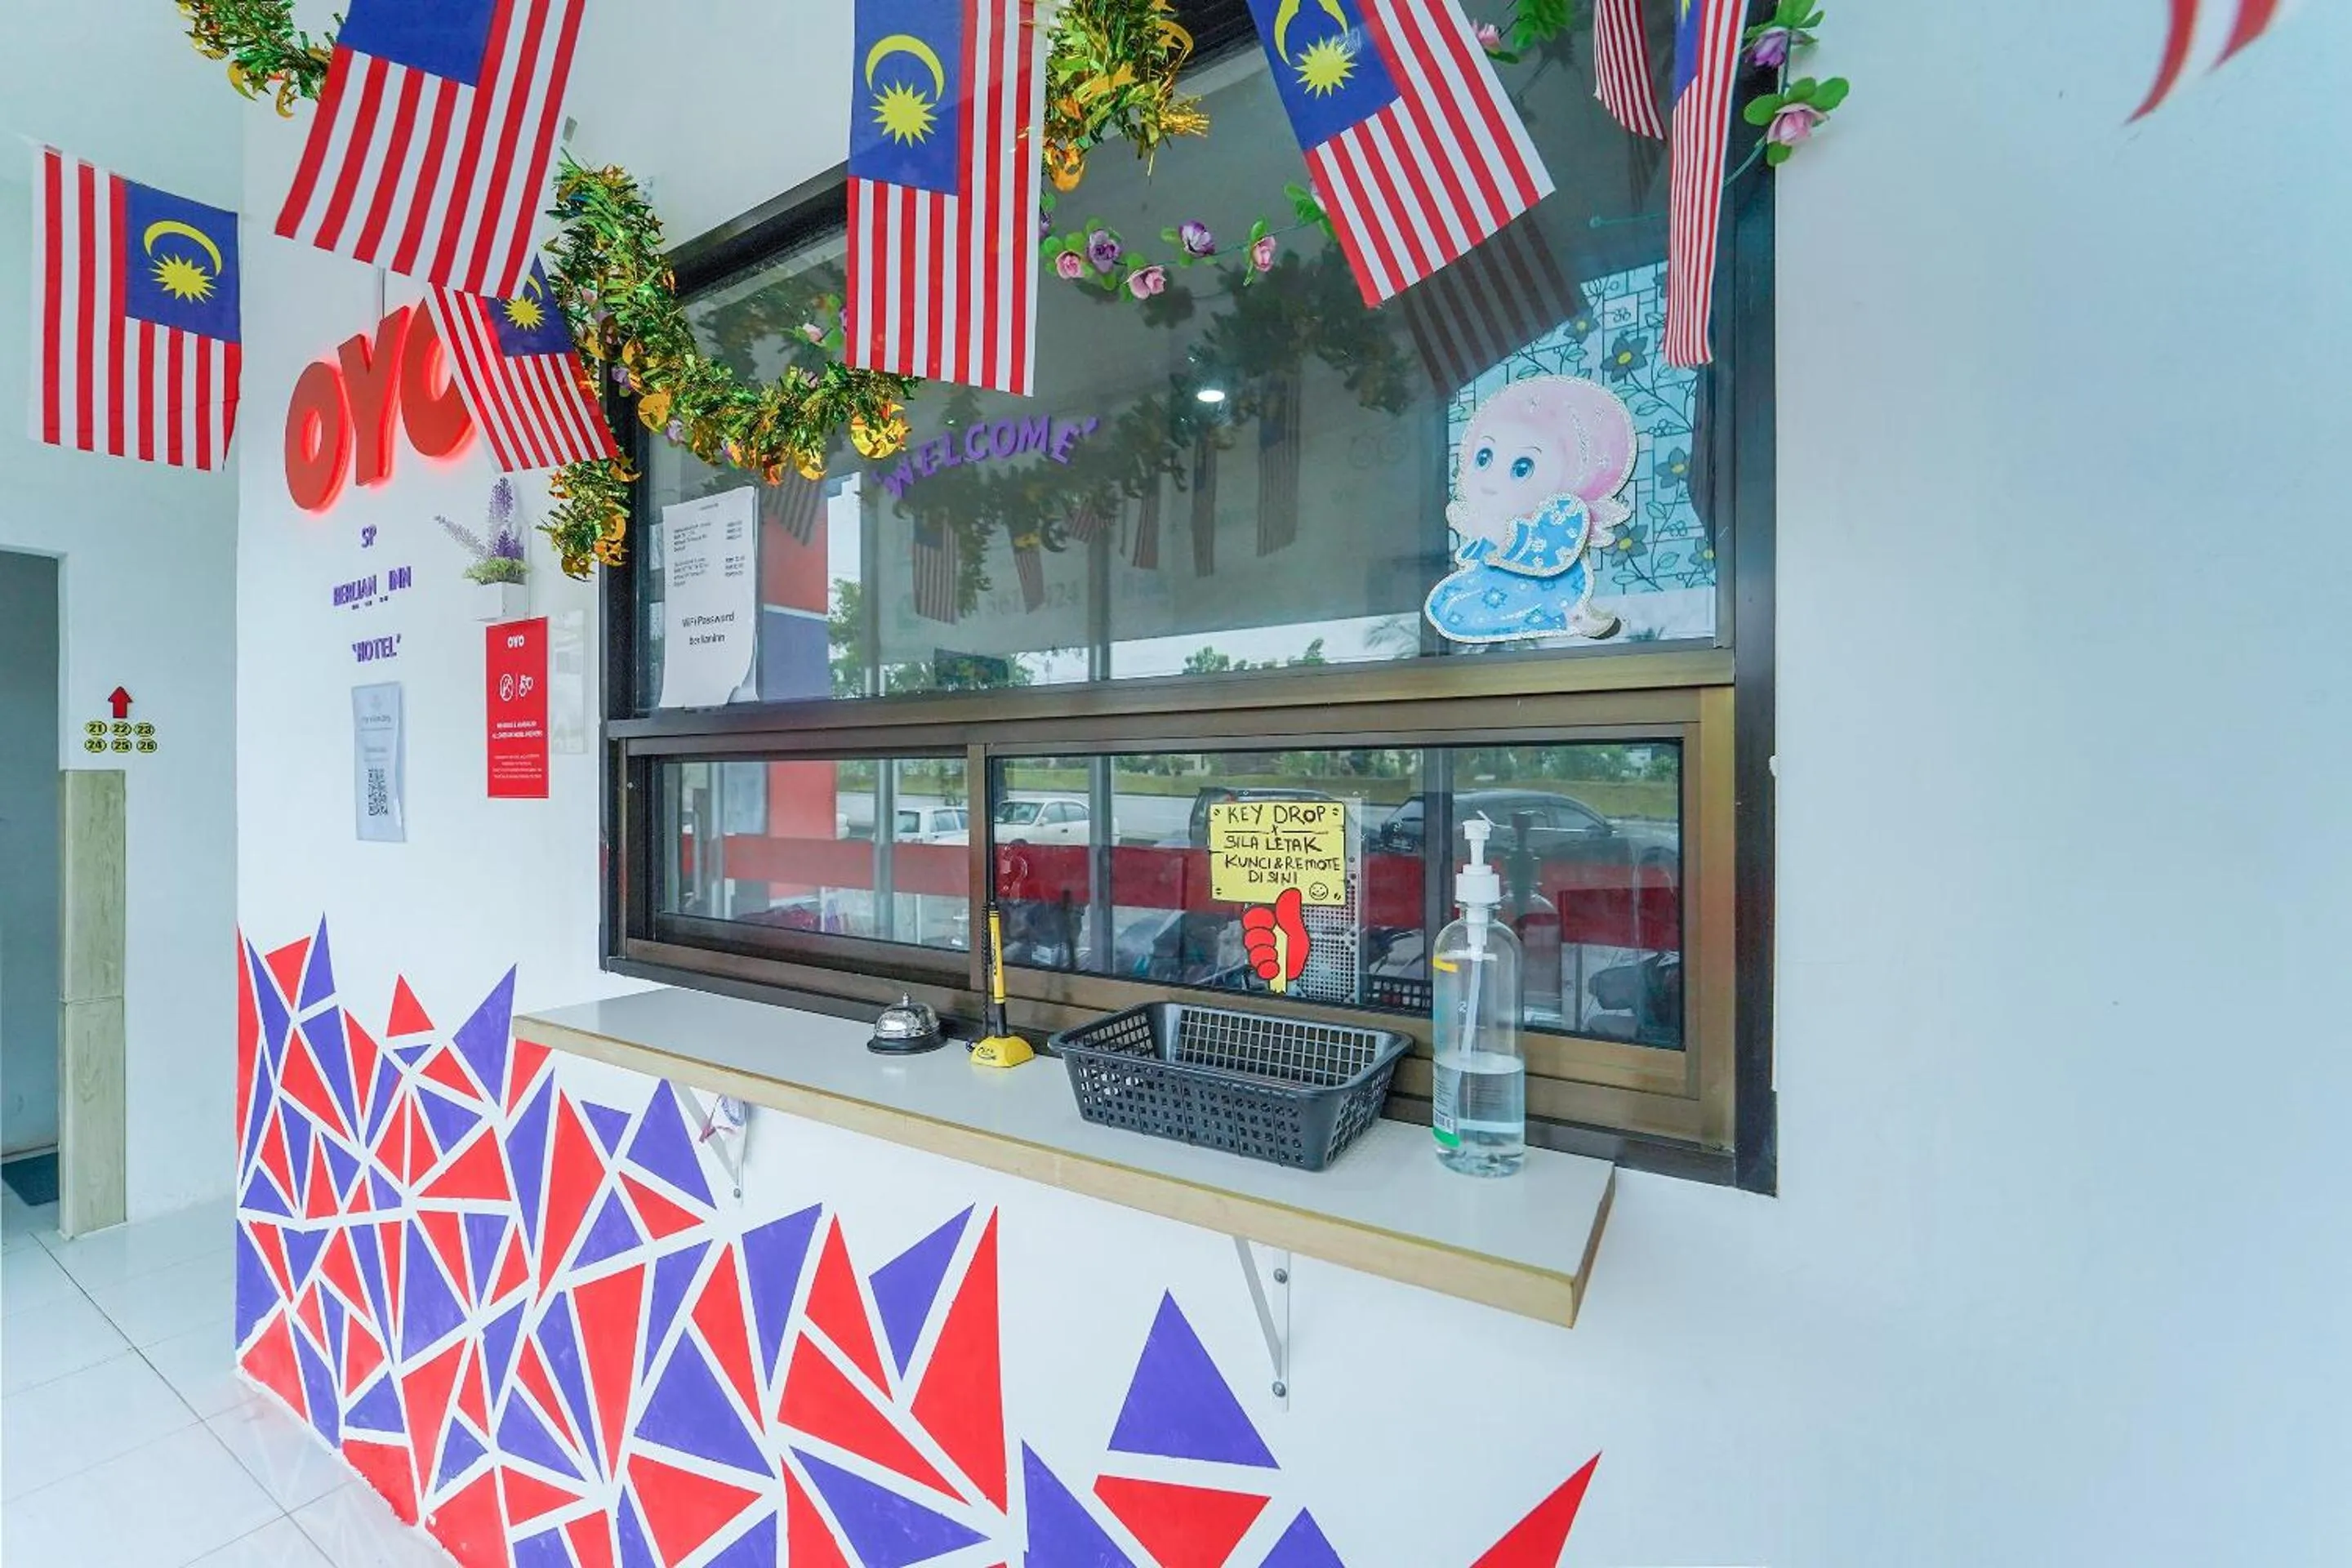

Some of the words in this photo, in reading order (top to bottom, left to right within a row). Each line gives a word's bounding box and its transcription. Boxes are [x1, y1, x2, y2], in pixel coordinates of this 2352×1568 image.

[361, 524, 376, 548] SP
[389, 566, 412, 591] INN
[507, 635, 524, 648] OYO
[1227, 804, 1263, 825] KEY
[1274, 804, 1326, 825] DROP
[1223, 835, 1259, 850] SILA
[1265, 836, 1323, 854] LETAK
